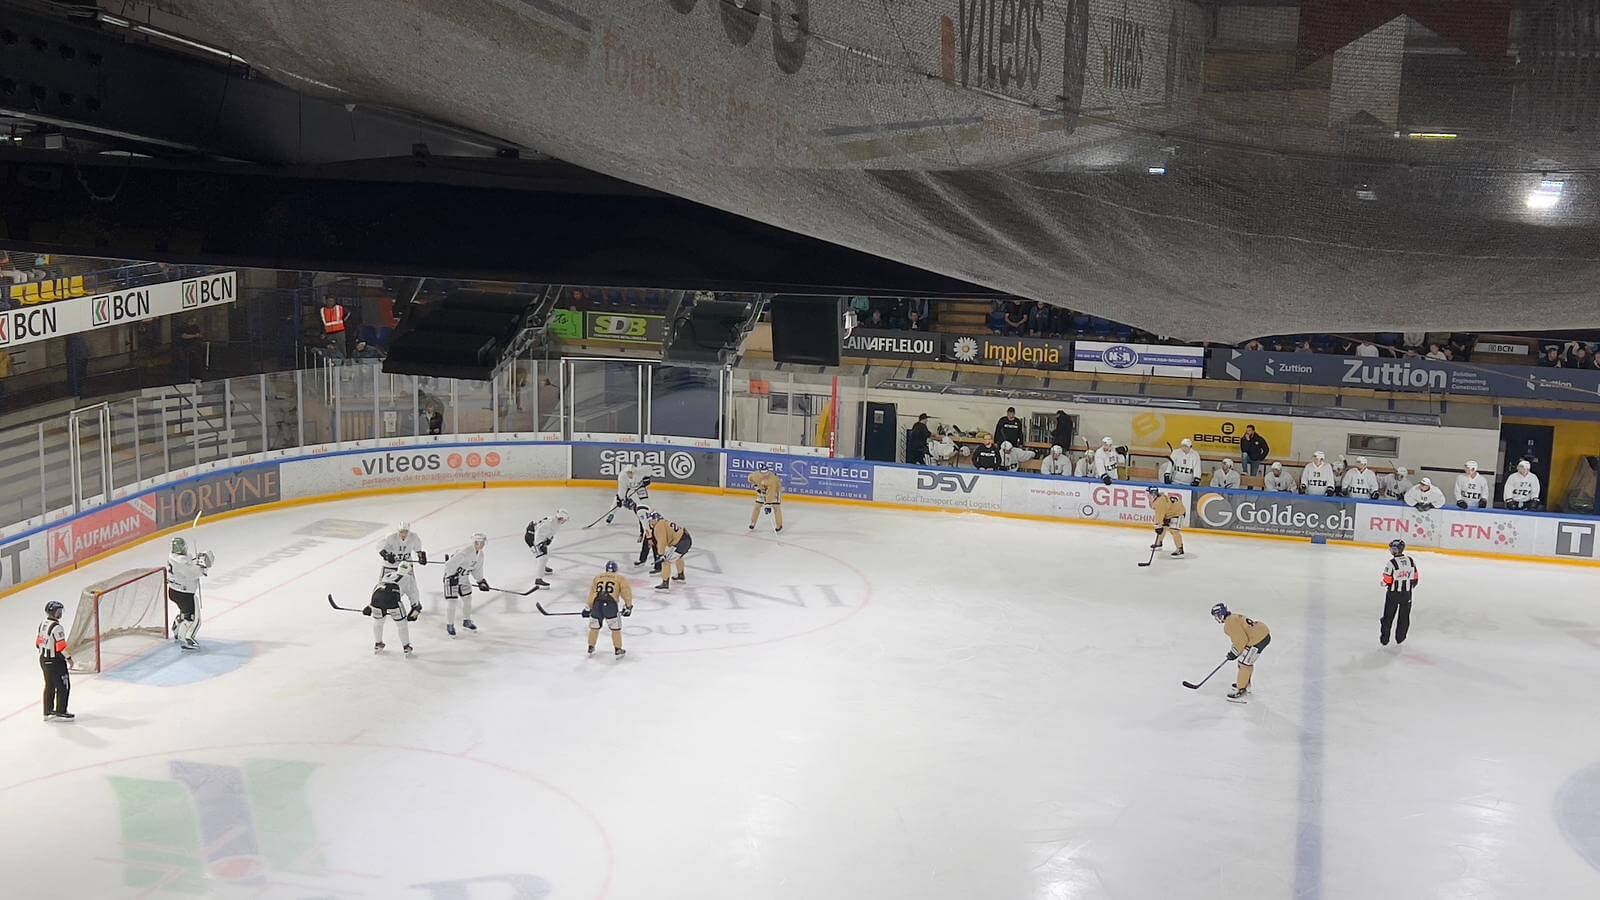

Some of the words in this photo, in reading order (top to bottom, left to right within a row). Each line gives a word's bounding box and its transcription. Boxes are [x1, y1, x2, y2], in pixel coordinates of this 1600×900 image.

[200, 275, 234, 302] BCN
[112, 291, 150, 321] BCN
[14, 308, 58, 337] BCN
[594, 315, 647, 336] SDB
[868, 337, 933, 354] AFFLELOU
[984, 340, 1060, 364] Implenia
[1497, 344, 1514, 352] BCN
[1279, 363, 1313, 374] Zuttion
[1342, 359, 1447, 388] Zuttion
[1194, 433, 1241, 445] BERGE
[362, 453, 441, 475] viteos
[600, 450, 665, 464] canal
[810, 465, 869, 479] SOMECO
[917, 471, 980, 493] DSV
[160, 471, 277, 523] HORLYNE
[1119, 513, 1155, 522] MACHIN
[1236, 502, 1354, 531] Goldec.ch
[1370, 517, 1410, 533] RTN
[1451, 523, 1491, 540] RTN
[0, 540, 30, 585] T
[596, 581, 616, 593] 66
[546, 621, 755, 641] GOUPE
